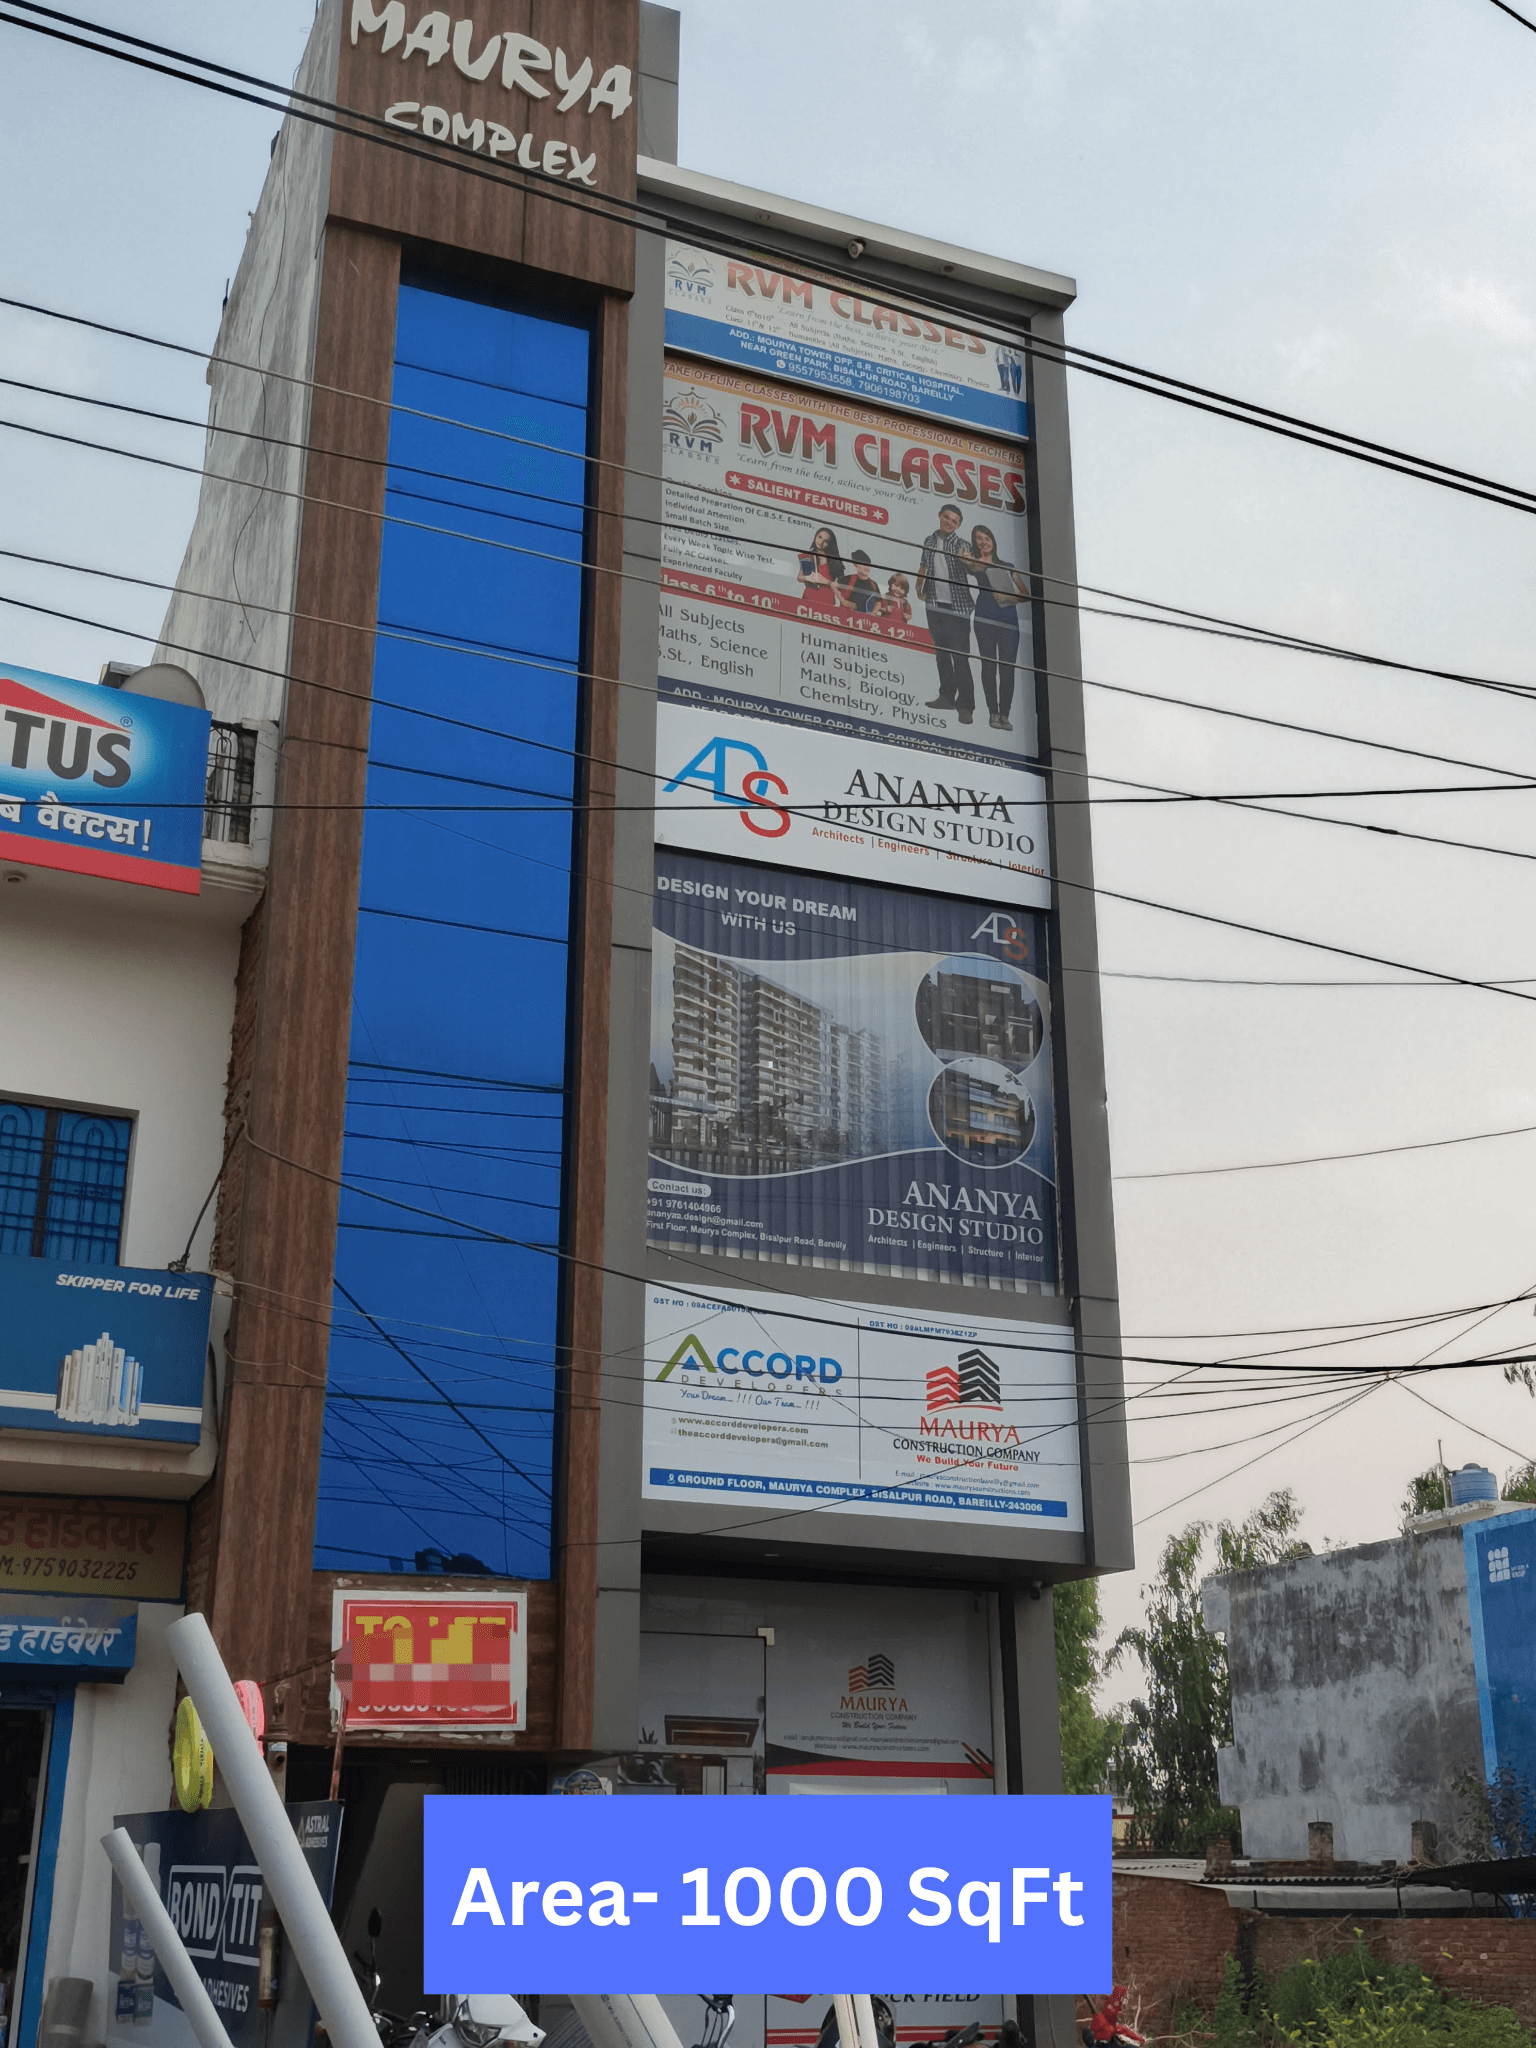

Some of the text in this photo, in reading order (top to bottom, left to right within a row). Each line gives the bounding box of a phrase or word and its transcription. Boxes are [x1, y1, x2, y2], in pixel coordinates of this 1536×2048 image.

[350, 0, 633, 119] MAURYA
[384, 101, 598, 186] COMPLEX
[675, 279, 706, 296] RVM
[725, 304, 745, 316] Class
[801, 323, 830, 338] Subjects
[726, 261, 813, 310] RVM
[829, 289, 987, 356] CLASSES
[740, 340, 955, 402] NEAR GREEN PARK, BISALPUR ROAD, BAREILLY
[757, 335, 797, 352] MOURYA
[798, 344, 832, 360] TOWER
[834, 353, 855, 367] OPP.
[876, 366, 920, 383] CRITICAL
[919, 376, 965, 397] HOSPITAL,
[663, 362, 1023, 464] TAKE OFFLINE CLASSES WITH THE BEST PROFESSIONAL TEACHERS
[669, 431, 713, 454] RVM
[740, 402, 1026, 515] RVM CLASSES
[768, 460, 794, 475] from
[794, 466, 811, 478] the
[837, 478, 872, 493] achieve
[873, 488, 896, 500] your
[665, 499, 706, 515] Individual
[665, 488, 700, 503] Detailed
[787, 516, 815, 530] Exams.
[747, 479, 869, 518] SALIENT FEATURES
[665, 511, 688, 522] Small
[689, 516, 712, 529] Batch
[663, 532, 686, 546] Every
[713, 543, 734, 557] Topic
[735, 549, 755, 561] Wise
[757, 554, 776, 566] Test.
[663, 544, 683, 557] Fully
[684, 549, 697, 559] AC
[662, 555, 743, 582] Experienced Faculty
[660, 573, 699, 594] lass
[727, 588, 746, 604] to
[680, 608, 746, 635] Subjects
[796, 604, 841, 626] Class
[709, 636, 769, 661] Science
[800, 631, 889, 663] Humanities
[700, 654, 755, 678] English
[800, 650, 906, 687] (All Subjects)
[800, 667, 920, 707] Maths, Biology,
[713, 694, 771, 716] MOURYA
[773, 707, 826, 727] TOWER
[799, 685, 884, 717] Chemistry,
[891, 706, 948, 729] Physics
[662, 736, 791, 839] ADS
[843, 768, 1015, 825] ANANYA
[36, 790, 152, 852] वैक्टस!
[822, 799, 1035, 856] DESIGN STUDIO
[812, 826, 865, 846] Architects
[877, 839, 930, 857] Engineers
[1008, 860, 1046, 877] Interior
[657, 876, 857, 922] DESIGN YOUR DREAM
[721, 910, 797, 937] WITH US
[651, 1180, 708, 1196] Contact us:
[901, 1180, 1043, 1222] ANANYA
[665, 1222, 690, 1235] Floor,
[690, 1225, 720, 1239] Maurya
[721, 1228, 759, 1242] Complex,
[759, 1232, 793, 1245] Bisalpur
[793, 1236, 818, 1248] Road,
[867, 1207, 1045, 1246] DESIGN STUDIO
[867, 1234, 1046, 1263] Architects Engineers Structure Interior
[56, 1273, 201, 1301] SKIPPER FOR LIFE
[653, 1297, 670, 1306] GST
[655, 1333, 843, 1385] ACCORD
[681, 1374, 842, 1396] DEVELOPERS
[919, 1415, 1022, 1446] MAURYA
[892, 1438, 1042, 1463] CONSTRUCTION COMPANY
[916, 1454, 1020, 1472] We Build Your Future
[677, 1474, 725, 1487] GROUND
[727, 1478, 768, 1491] FLOOR,
[768, 1480, 814, 1495] MAURYA
[815, 1485, 870, 1499] COMPLEX,
[872, 1489, 923, 1503] BISALPUR
[924, 1493, 958, 1507] ROAD,
[830, 1711, 918, 1721] CONSTRUCTION COMPANY
[839, 1695, 909, 1712] MAURYA
[304, 1814, 330, 1834] ASTRAL
[169, 1880, 222, 1941] BOND
